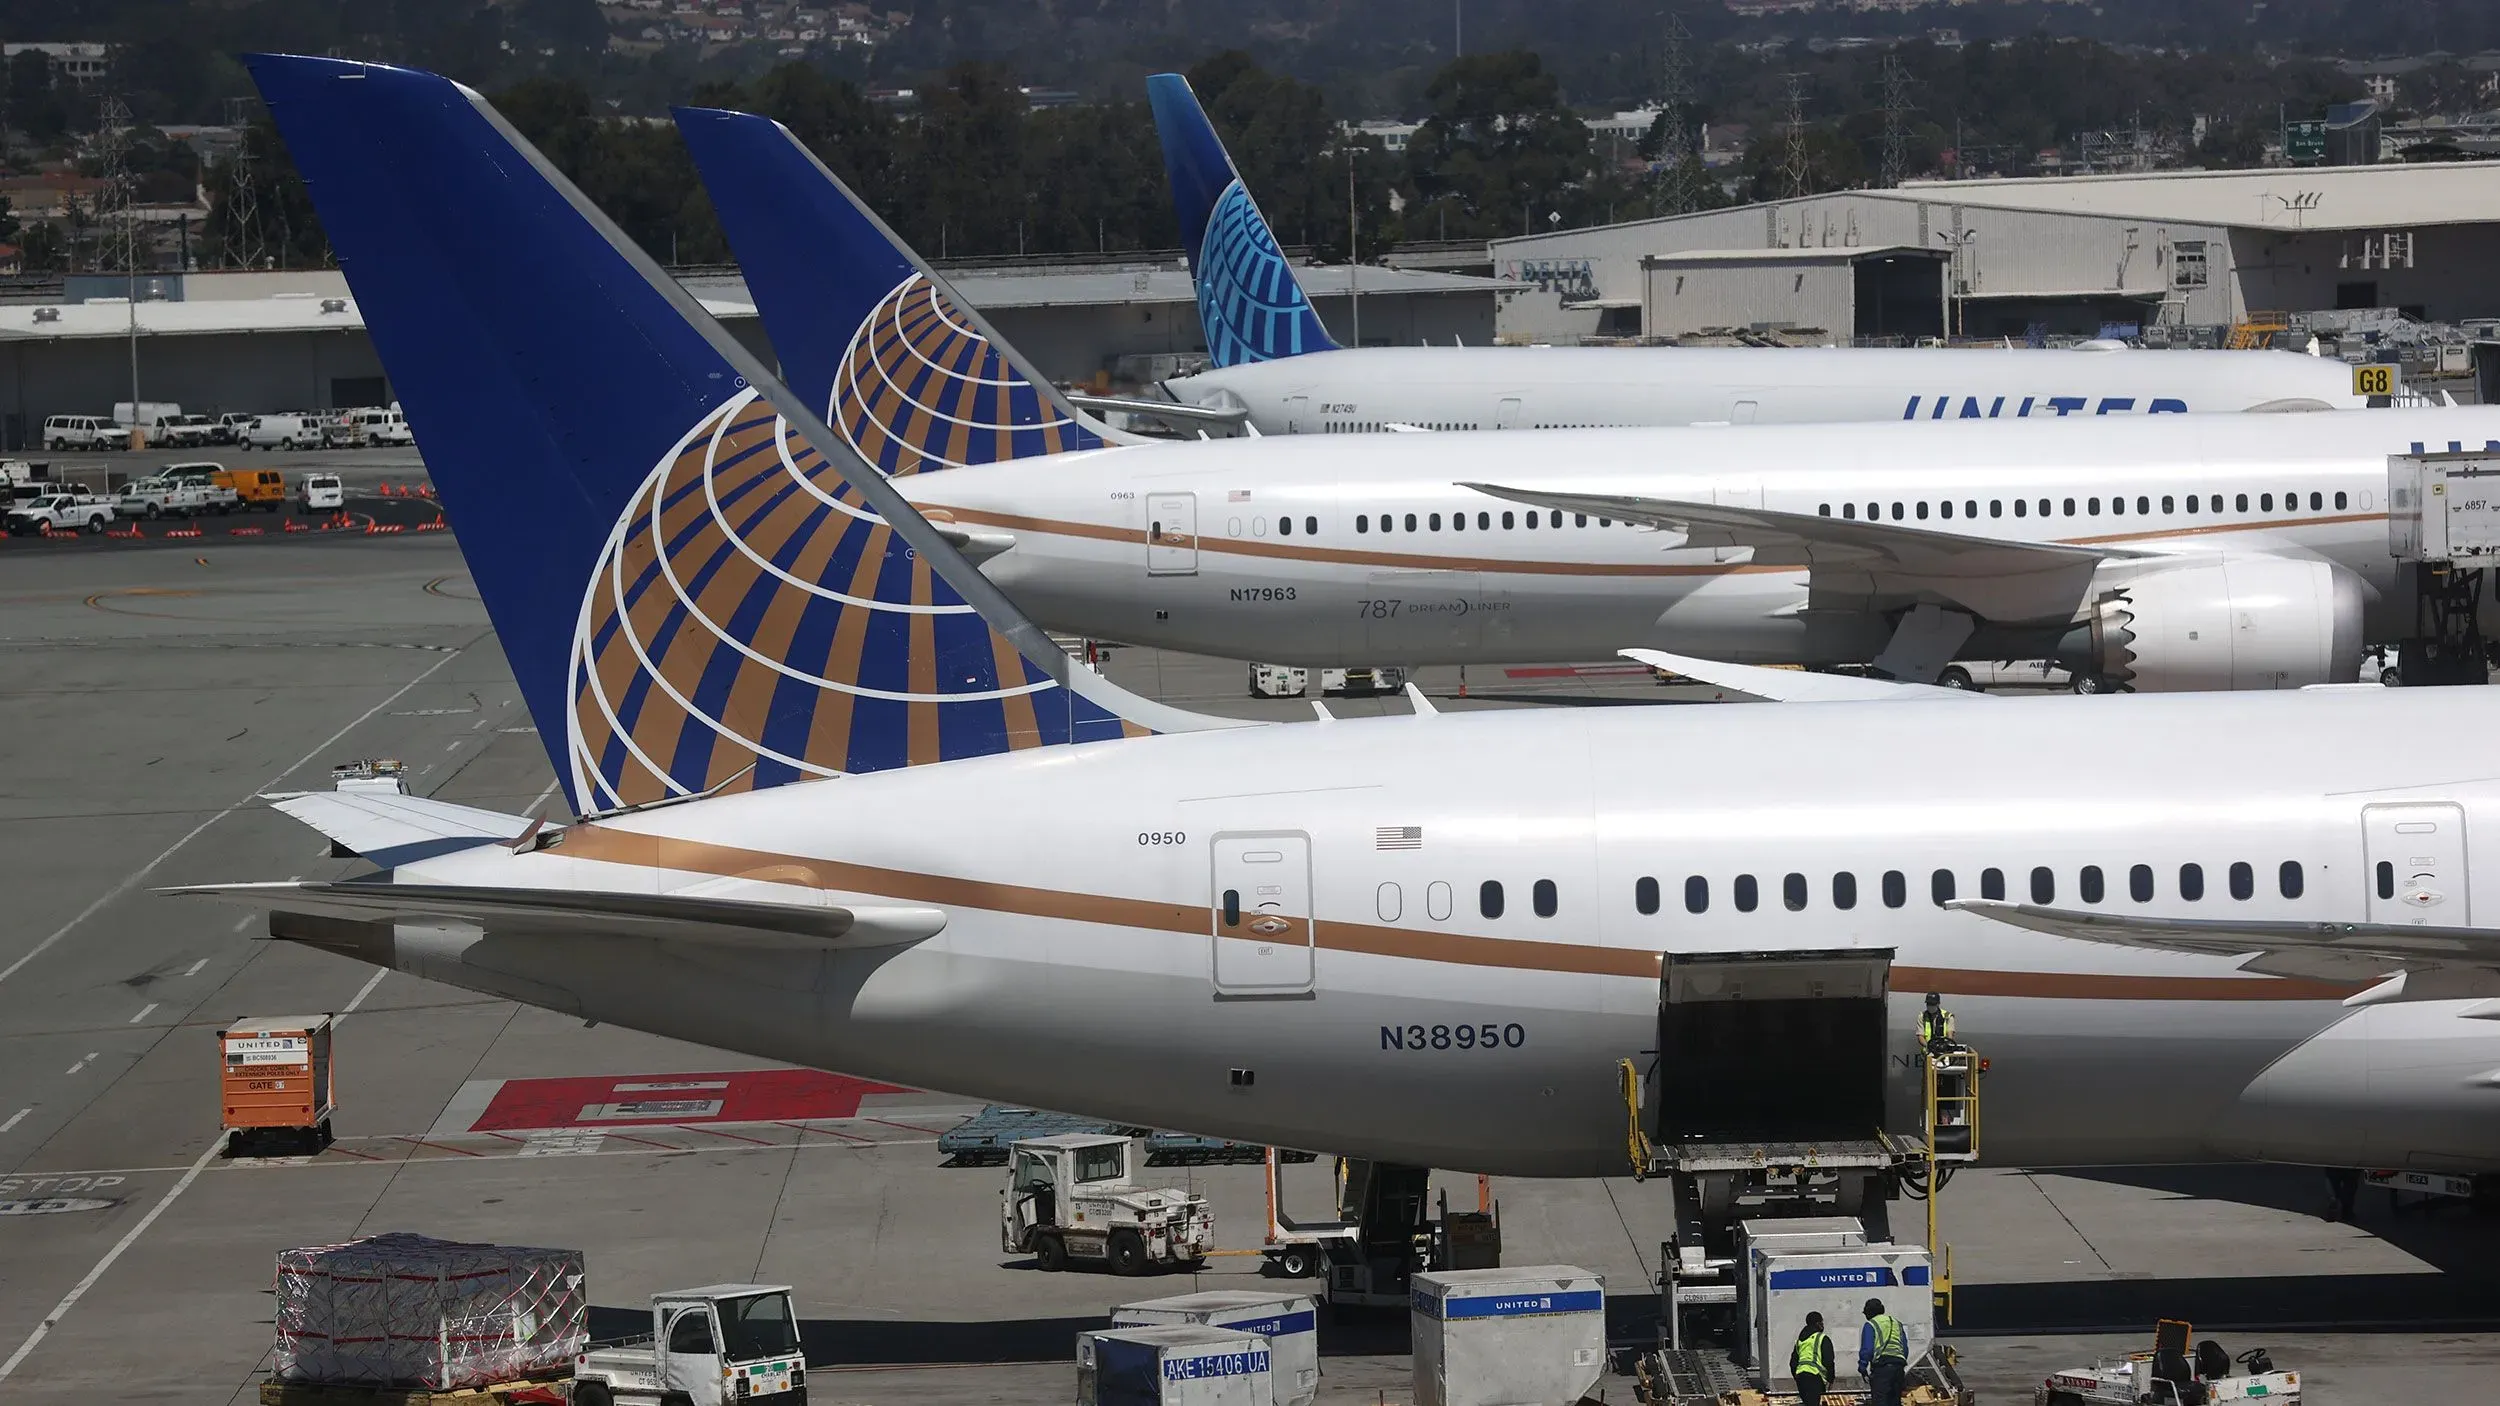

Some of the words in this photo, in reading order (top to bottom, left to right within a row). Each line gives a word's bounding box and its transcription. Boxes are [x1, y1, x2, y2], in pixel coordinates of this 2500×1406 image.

[1522, 260, 1593, 281] DELTA
[2359, 369, 2387, 393] G8
[1110, 492, 1135, 500] 0963
[2464, 500, 2487, 510] 6857
[1230, 587, 1297, 601] N17963
[1357, 599, 1402, 619] 787
[2029, 660, 2047, 669] AB
[1138, 831, 1186, 845] 0950
[1380, 1023, 1525, 1050] N38950
[238, 1041, 280, 1049] UNITED
[249, 1081, 273, 1090] GATE
[0, 1176, 126, 1194] STOP
[1820, 1274, 1864, 1283] UNITED
[1495, 1300, 1538, 1309] UNITED
[1168, 1357, 1195, 1380] AKE
[1199, 1353, 1243, 1377] 15406
[1248, 1350, 1267, 1372] UA
